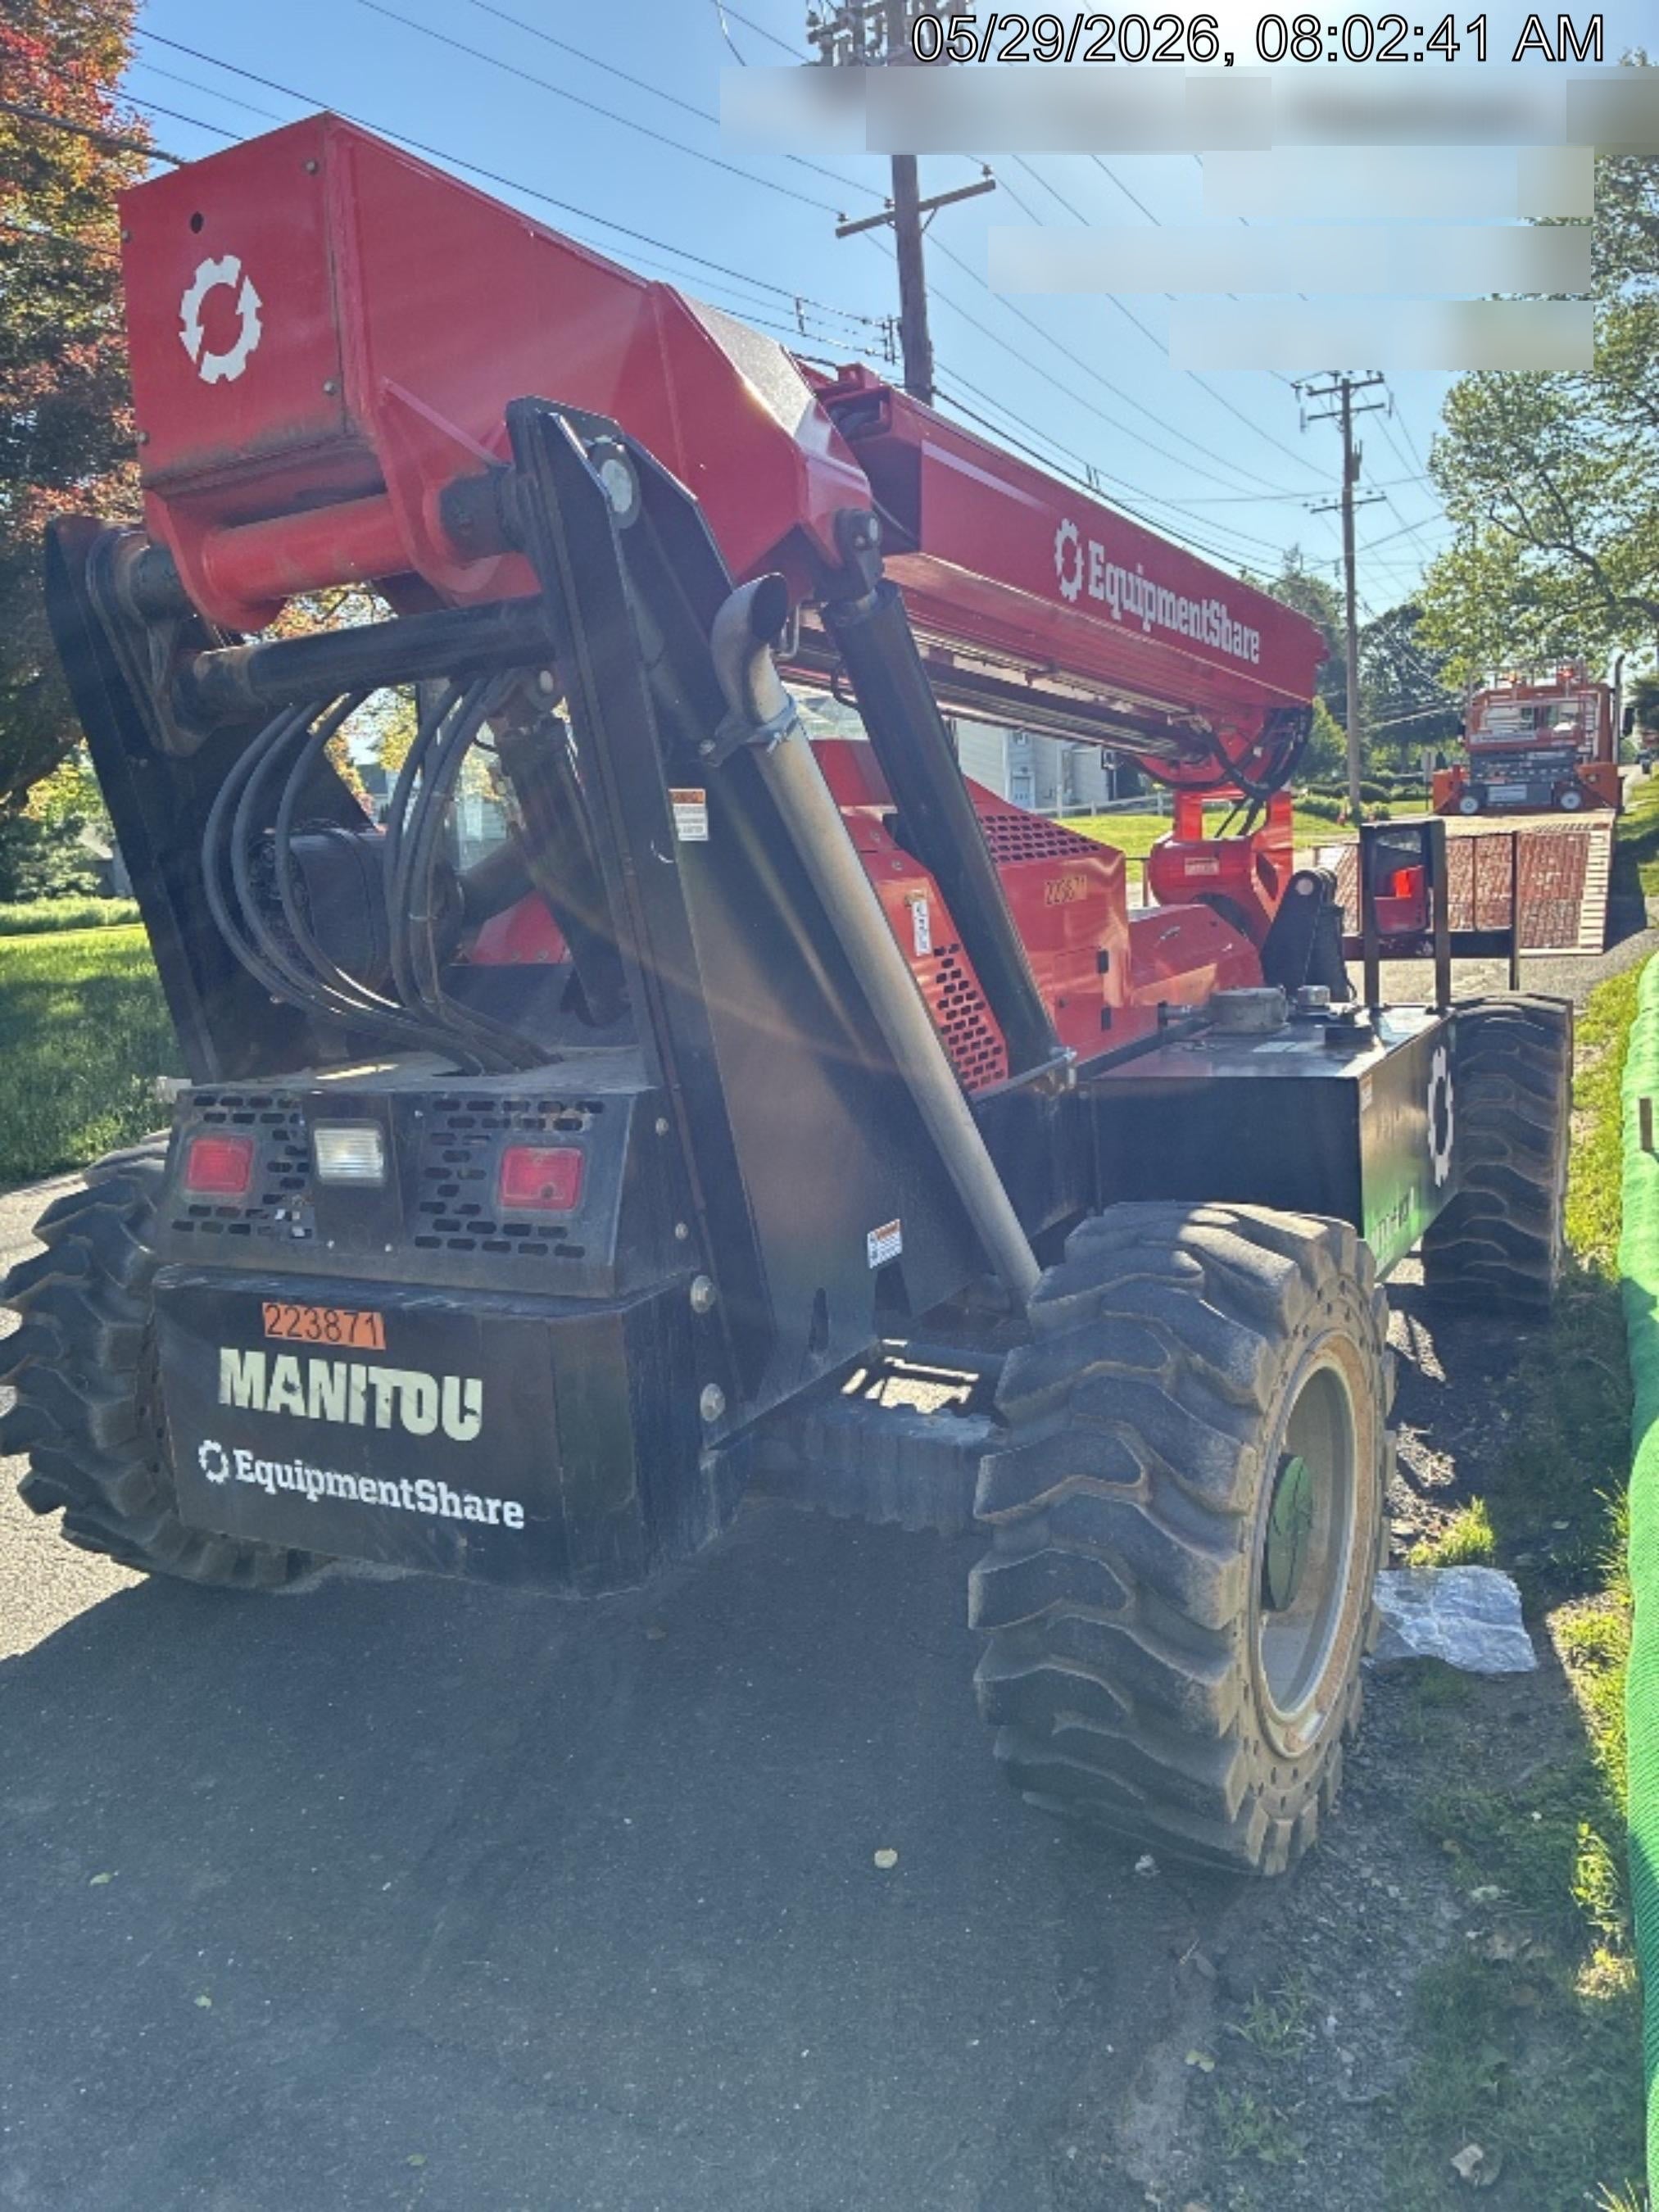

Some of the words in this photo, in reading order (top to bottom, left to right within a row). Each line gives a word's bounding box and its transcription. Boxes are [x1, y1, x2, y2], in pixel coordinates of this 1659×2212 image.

[1088, 540, 1261, 664] EquipmentShare
[265, 1304, 377, 1346] 223871
[218, 1347, 483, 1442] MANITOU
[233, 1449, 525, 1530] EquipmentShare
